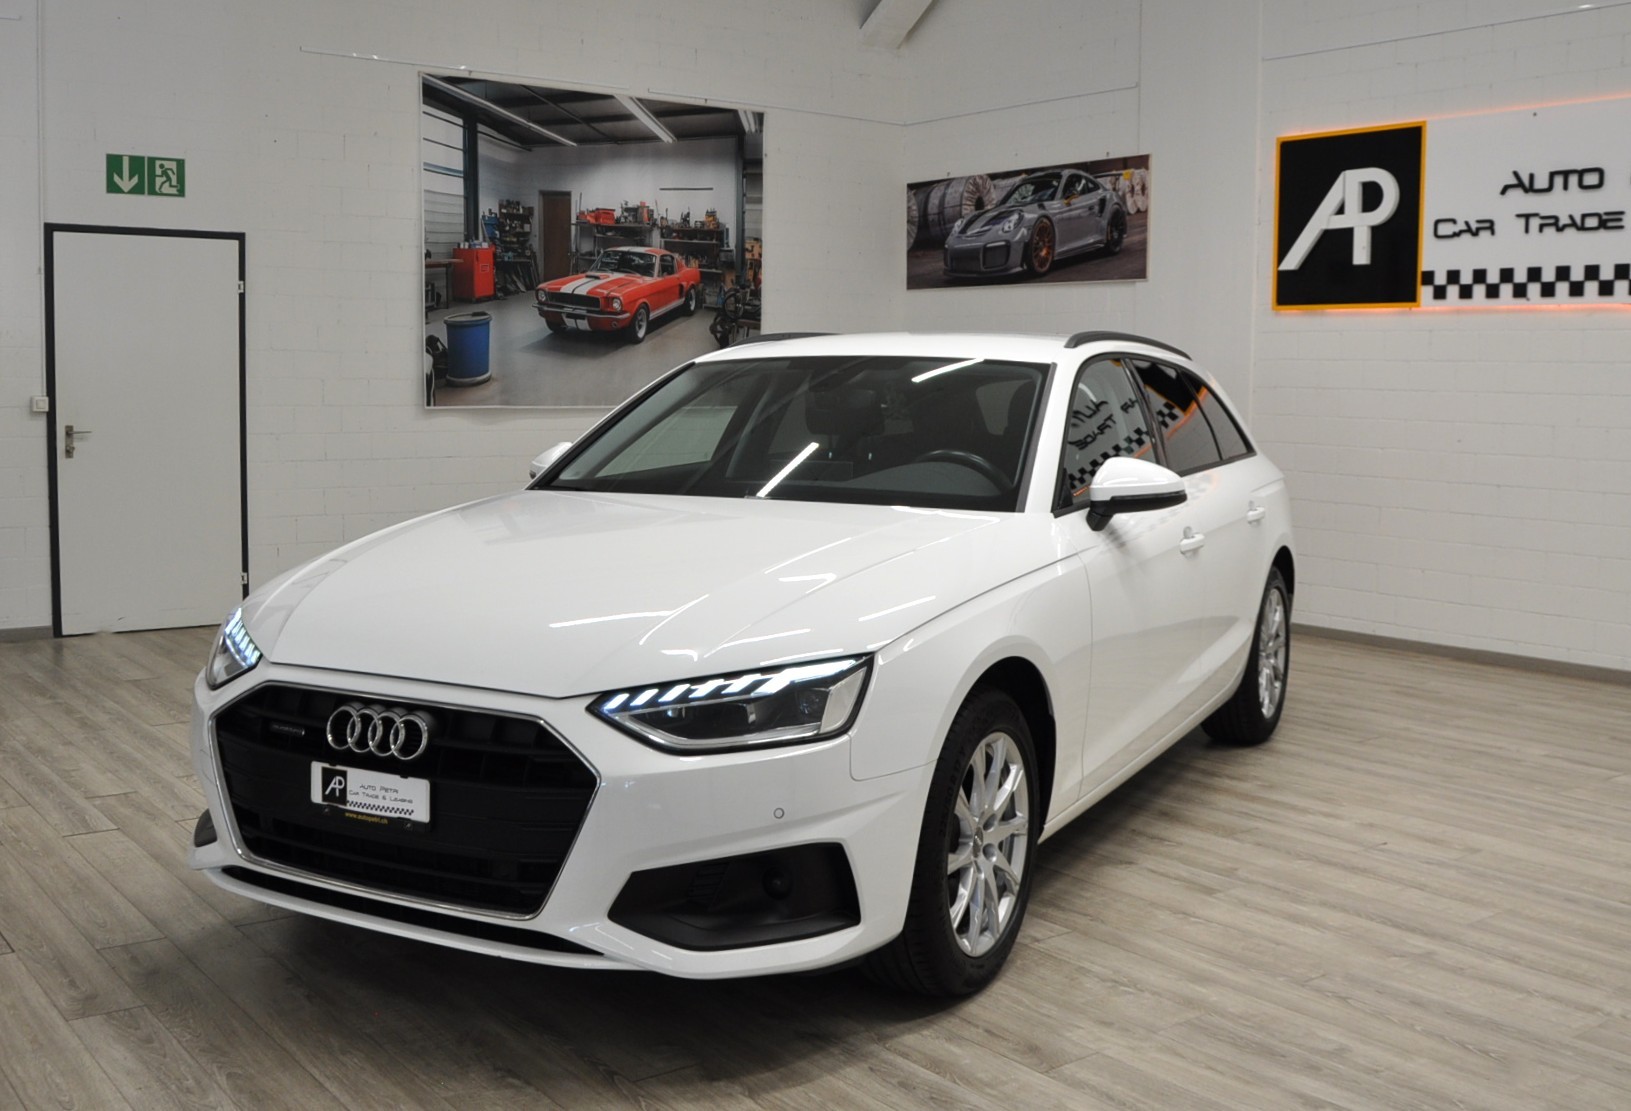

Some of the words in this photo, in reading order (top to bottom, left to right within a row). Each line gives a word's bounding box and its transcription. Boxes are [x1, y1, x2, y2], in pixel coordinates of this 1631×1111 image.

[1500, 167, 1605, 196] AUTO
[1433, 218, 1496, 239] CAR
[1515, 211, 1626, 234] TRADE
[360, 784, 377, 792] AUTO
